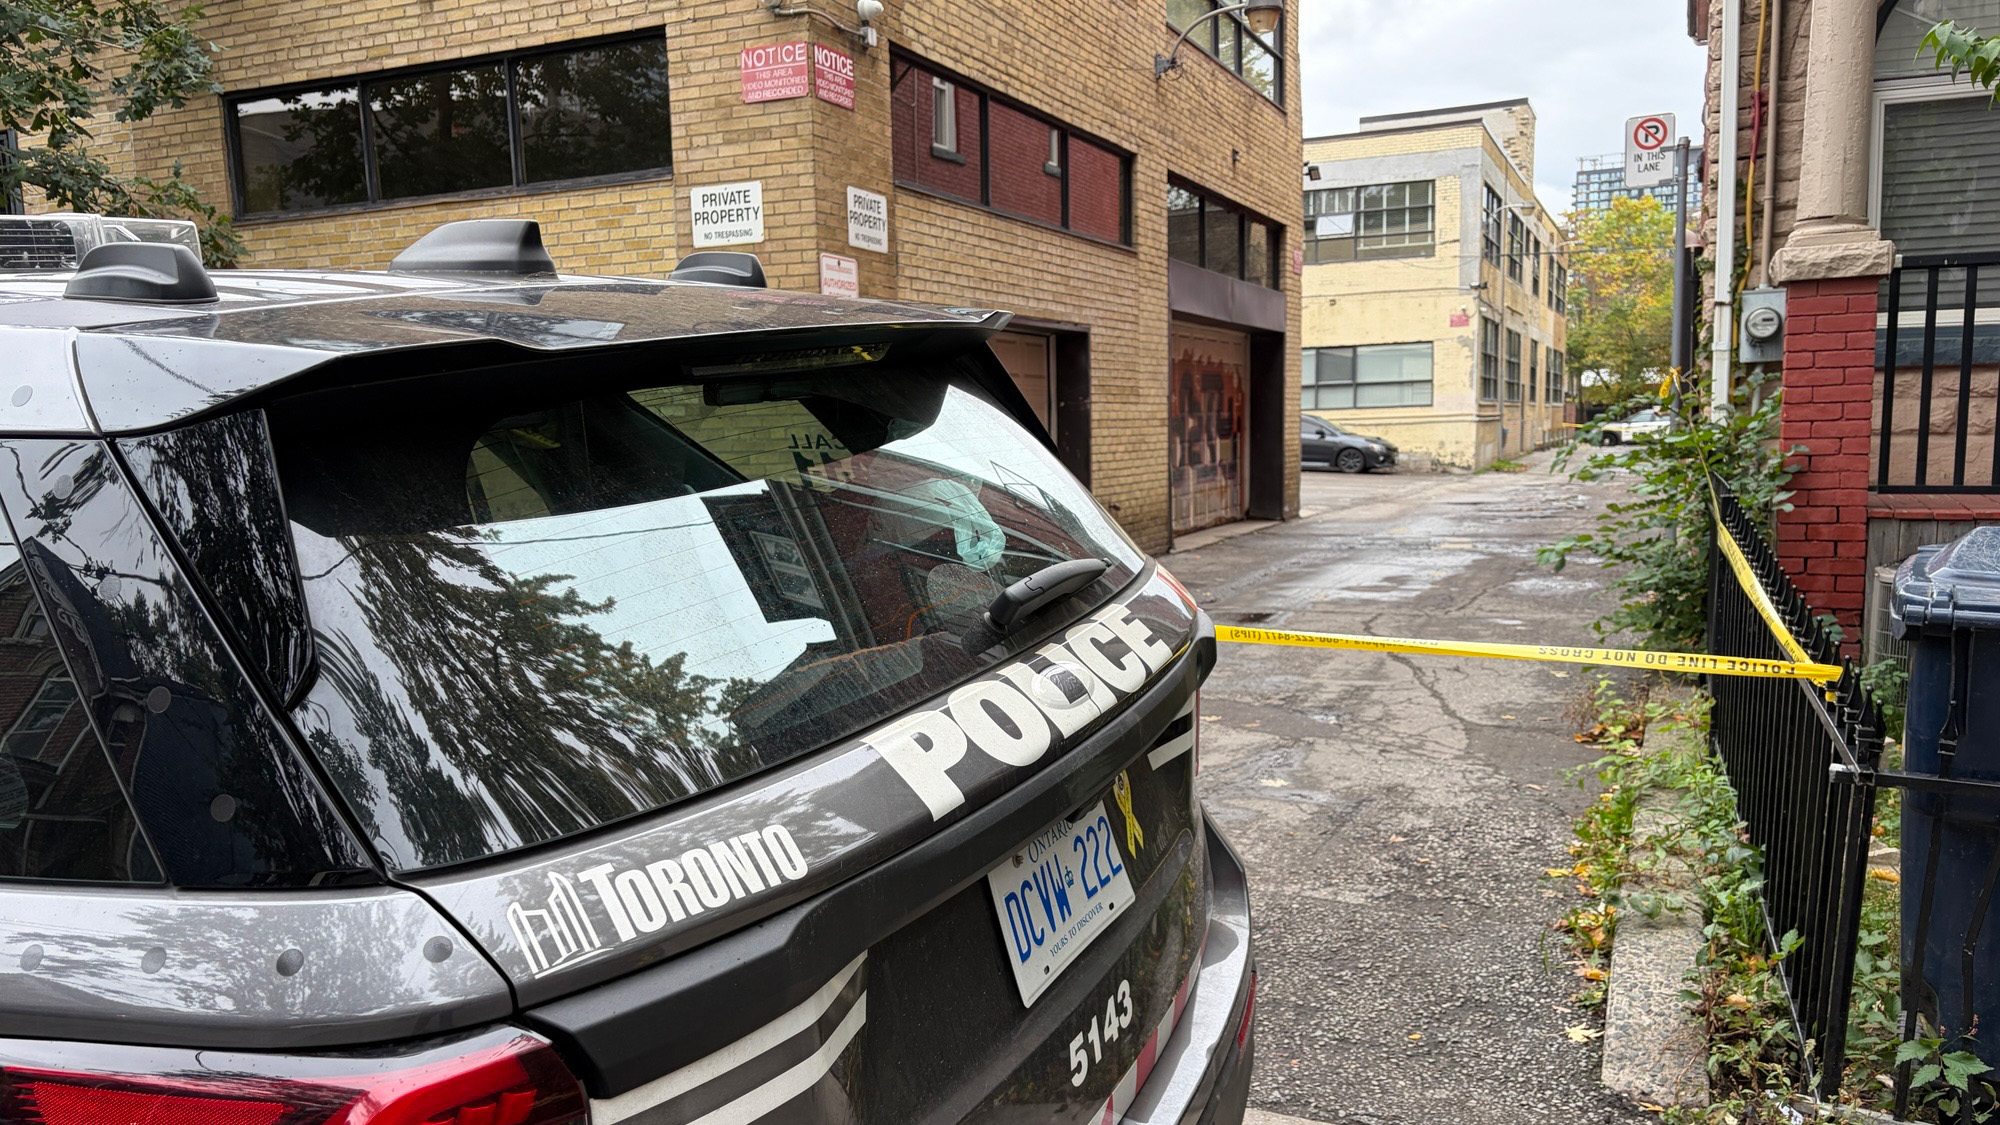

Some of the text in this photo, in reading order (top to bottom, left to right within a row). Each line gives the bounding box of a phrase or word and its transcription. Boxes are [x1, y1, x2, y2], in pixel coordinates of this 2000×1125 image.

[741, 43, 806, 68] NOTICE
[814, 44, 854, 77] NOTICE
[743, 75, 808, 91] VIDEO MONITORED
[755, 67, 793, 80] THIS AREA
[747, 85, 804, 99] AND RECORDED
[1633, 151, 1666, 163] IN THIS
[1637, 162, 1661, 173] LANE
[702, 189, 751, 208] PRIVATE
[853, 194, 881, 214] PRIVATE
[694, 206, 760, 226] PROPERTY
[849, 210, 887, 232] PROPERTY
[704, 228, 753, 240] NO TRESPASSING
[1538, 647, 1796, 675] POLICE LINE DO NOT CROSS
[859, 603, 1173, 822] POLICE
[1028, 819, 1074, 863] ONTARIO
[577, 824, 809, 943] TORONTO
[1004, 853, 1072, 964] DCVW
[1073, 815, 1123, 900] 222
[1050, 901, 1104, 957] YOURS TO DISCOVER
[1069, 979, 1133, 1087] 5143
